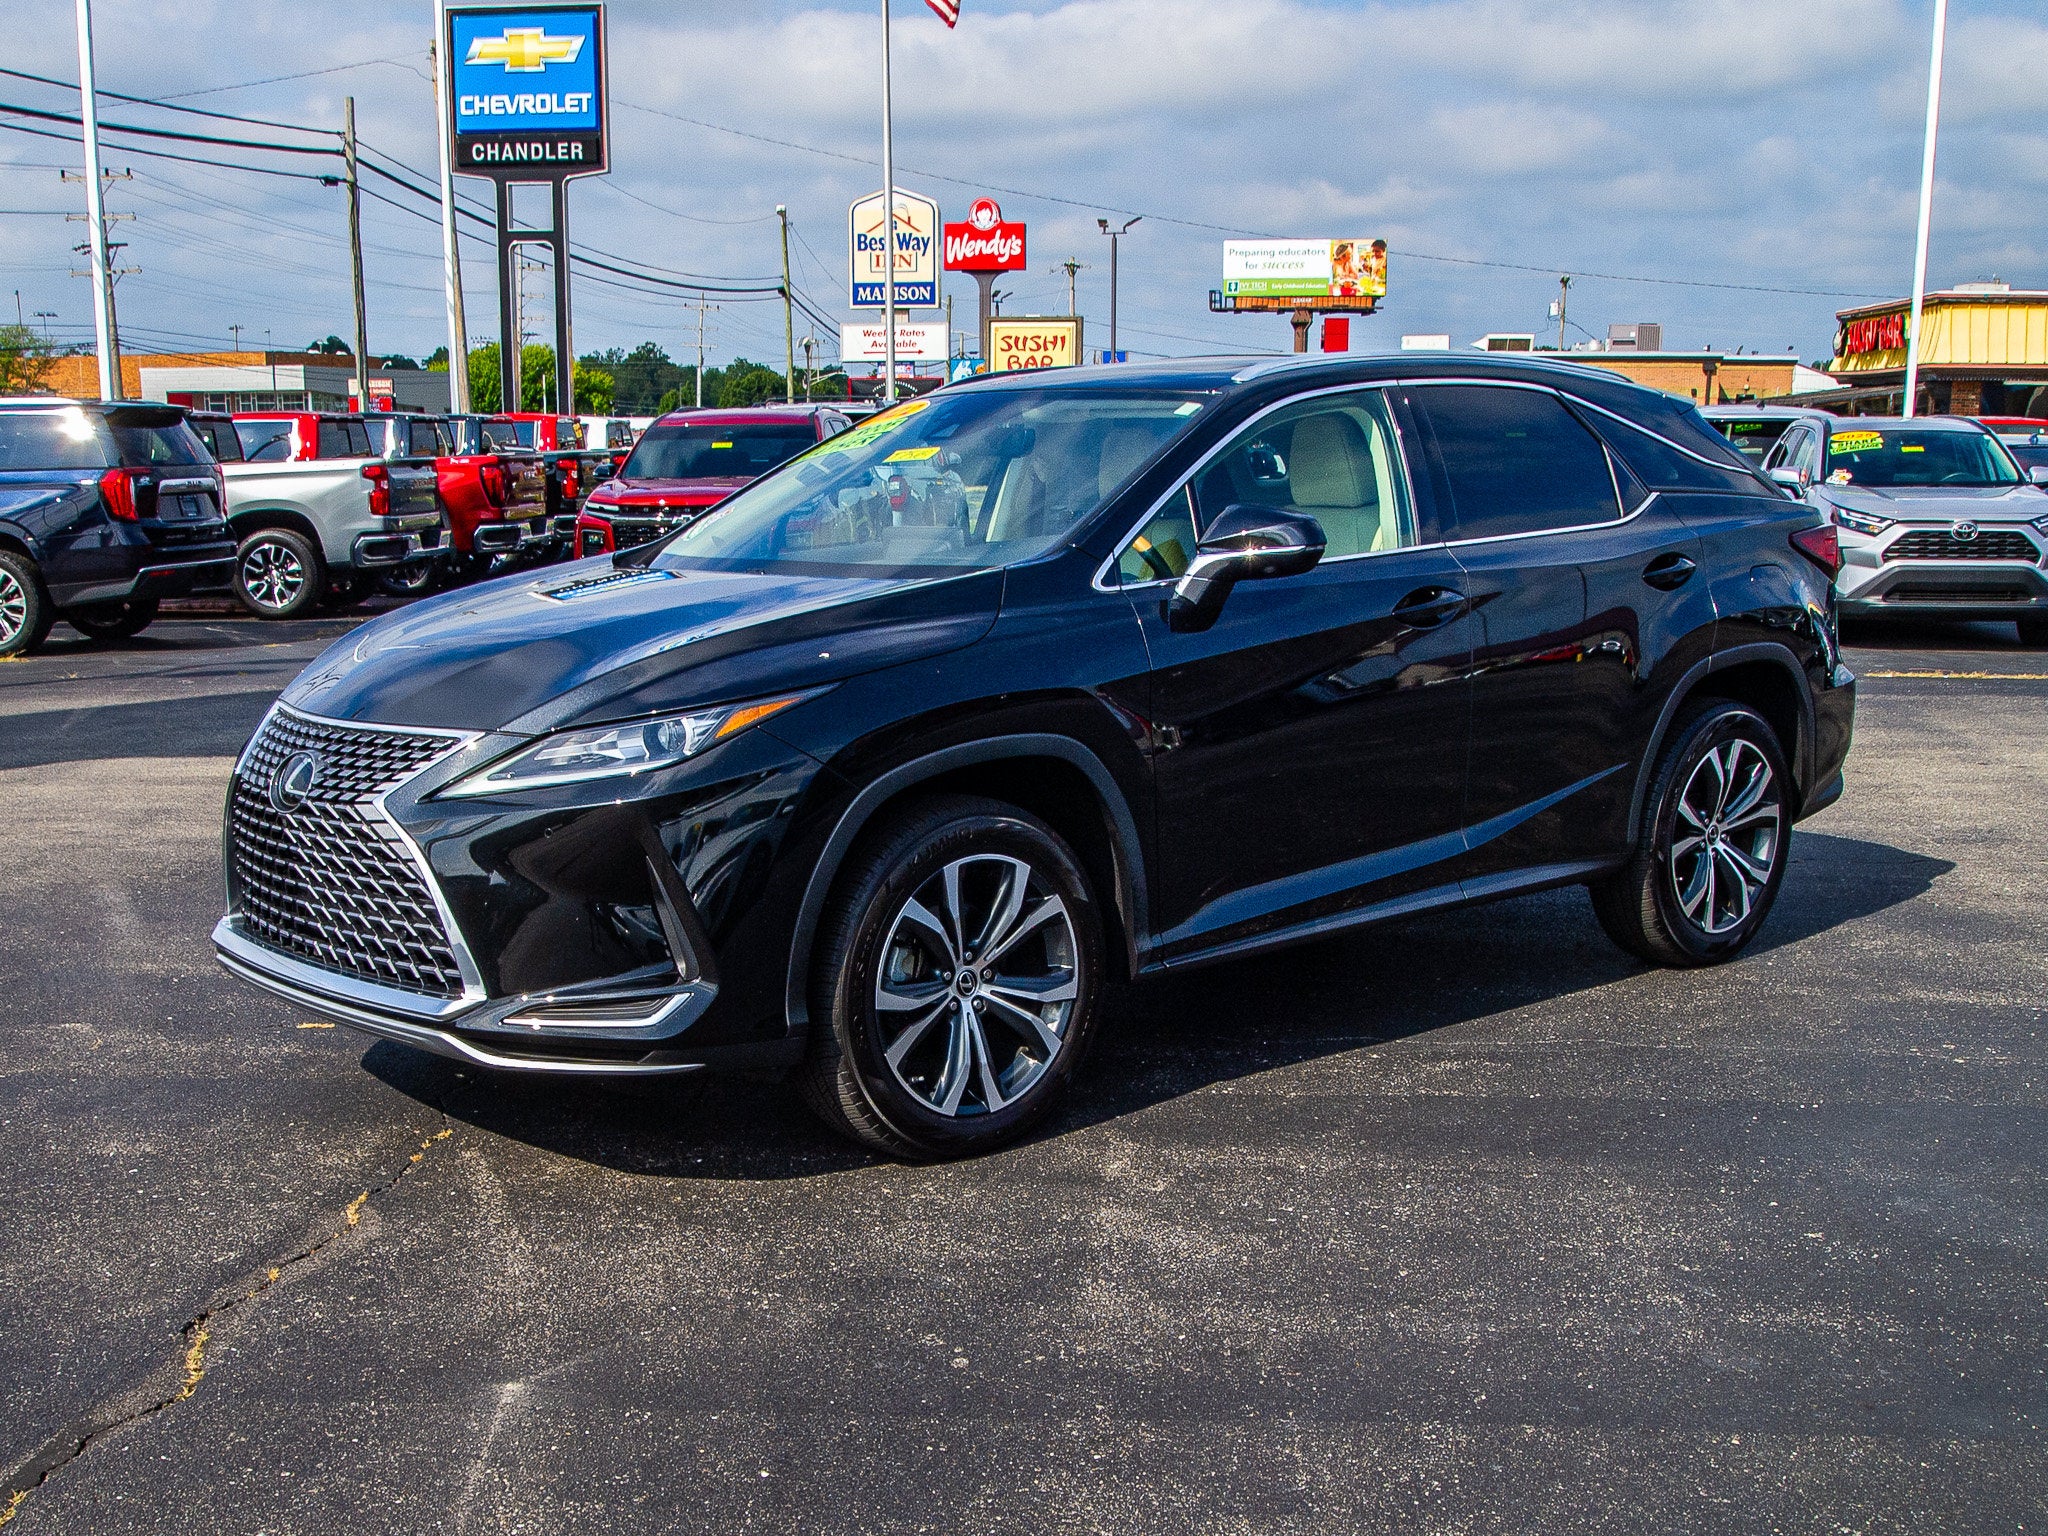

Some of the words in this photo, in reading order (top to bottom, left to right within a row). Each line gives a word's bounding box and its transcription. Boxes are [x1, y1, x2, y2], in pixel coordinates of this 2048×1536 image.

[460, 92, 592, 117] CHEVROLET
[471, 141, 584, 161] CHANDLER
[857, 233, 887, 252] Bes
[896, 232, 930, 257] Way
[946, 228, 1022, 264] Wendy's
[1229, 248, 1275, 258] Preparing
[1278, 247, 1326, 257] educators
[1245, 260, 1258, 269] for
[1262, 261, 1305, 270] success
[899, 328, 926, 338] Rates
[870, 339, 917, 349] Avaable
[1000, 334, 1066, 353] SUSHI
[1007, 354, 1054, 371] BAR
[1838, 438, 1877, 449] SHARP
